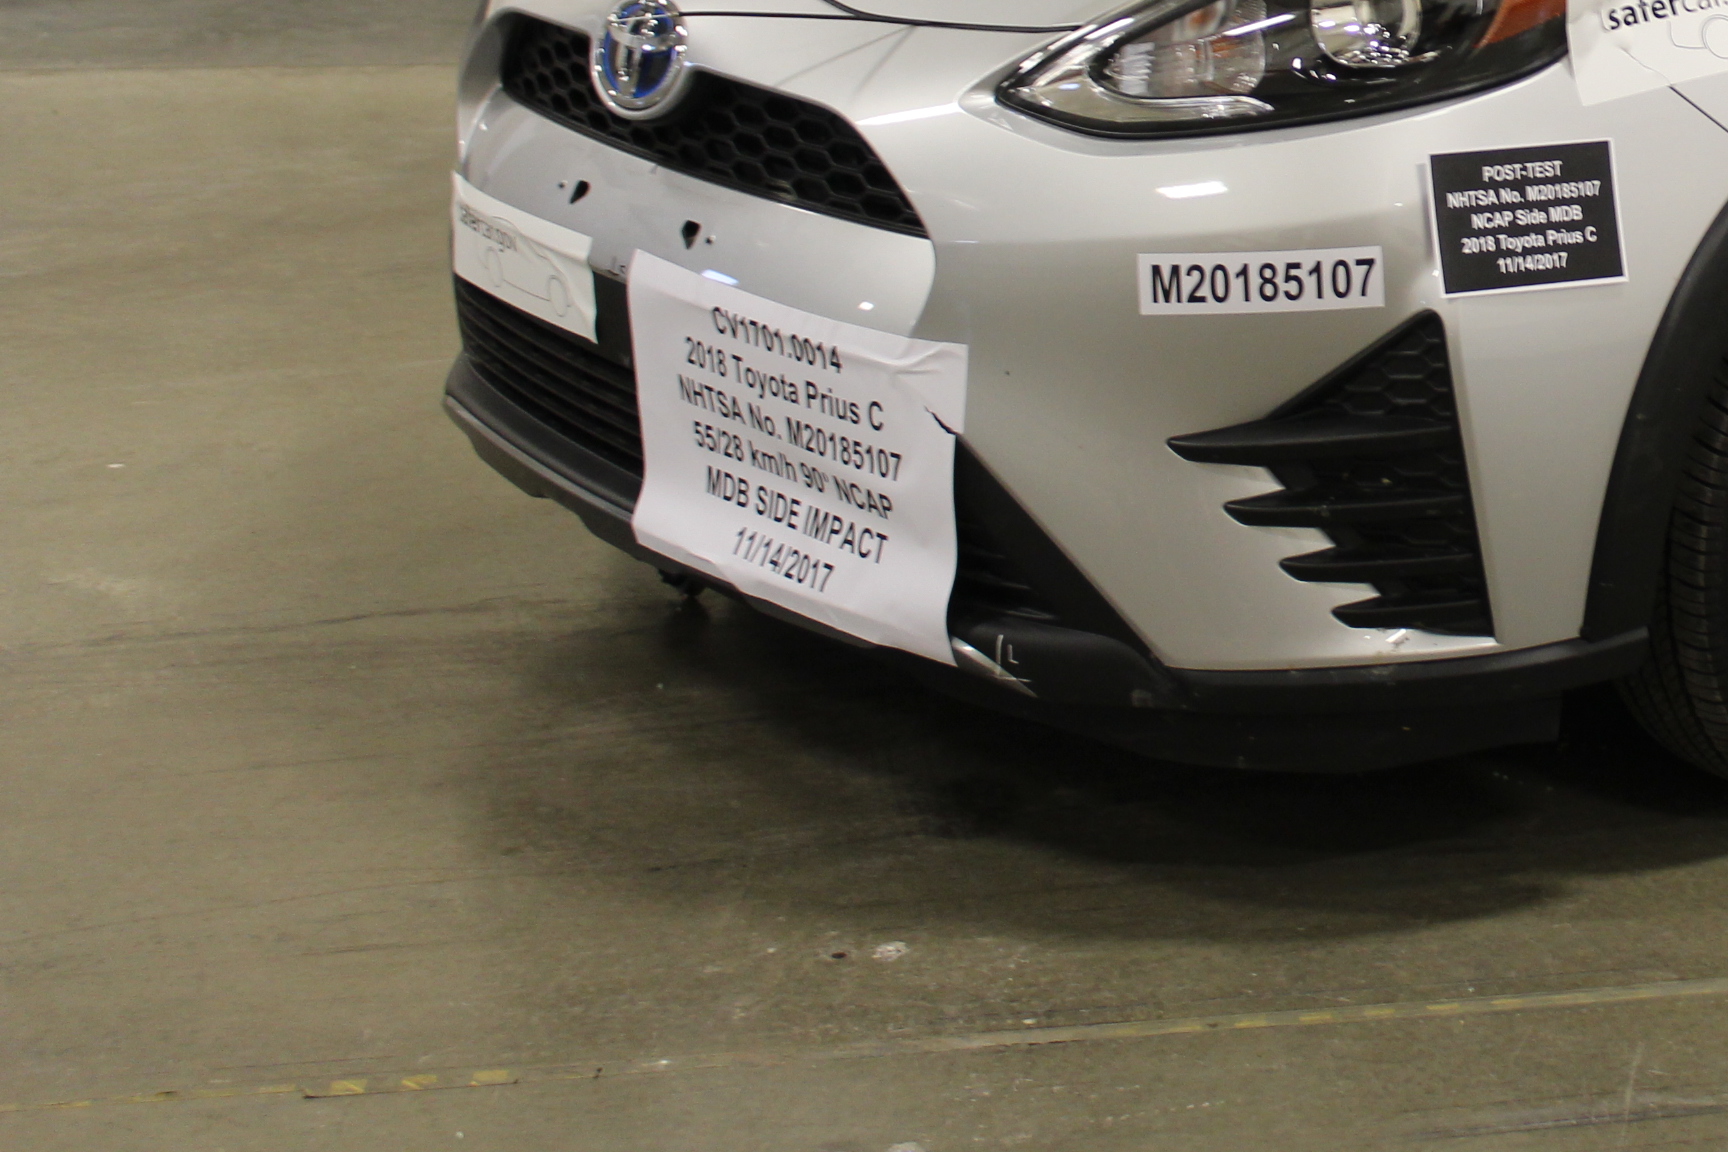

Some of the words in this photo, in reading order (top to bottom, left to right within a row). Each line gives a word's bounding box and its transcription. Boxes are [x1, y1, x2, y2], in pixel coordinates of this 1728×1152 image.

[1446, 189, 1499, 209] NHTSA
[1499, 187, 1525, 204] No.
[1525, 180, 1601, 202] M20185107
[1482, 160, 1563, 182] POST-TEST
[1460, 237, 1496, 254] 2018
[1496, 232, 1545, 253] Toyota
[1546, 229, 1584, 246] Prius
[1584, 226, 1597, 242] C
[1471, 211, 1514, 230] NCAP
[1514, 208, 1547, 226] Side
[1548, 205, 1583, 223] MDB
[1151, 258, 1376, 304] M20185107
[1497, 252, 1568, 274] 11/14/2017
[711, 306, 843, 374] CV1701.0014
[684, 336, 728, 377] 2018
[731, 355, 800, 405] Toyota
[805, 380, 860, 427] Prius
[868, 401, 884, 431] C
[678, 374, 745, 421] NHTSA
[748, 402, 782, 441] No.
[786, 417, 903, 482] M20185107
[693, 421, 745, 462] 55/28
[751, 441, 798, 483] km/h
[833, 475, 893, 520] NCAP
[706, 465, 750, 508] MDB
[755, 485, 800, 530] SIDE
[803, 504, 888, 564] IMPACT
[732, 527, 835, 593] 11/14/2017
